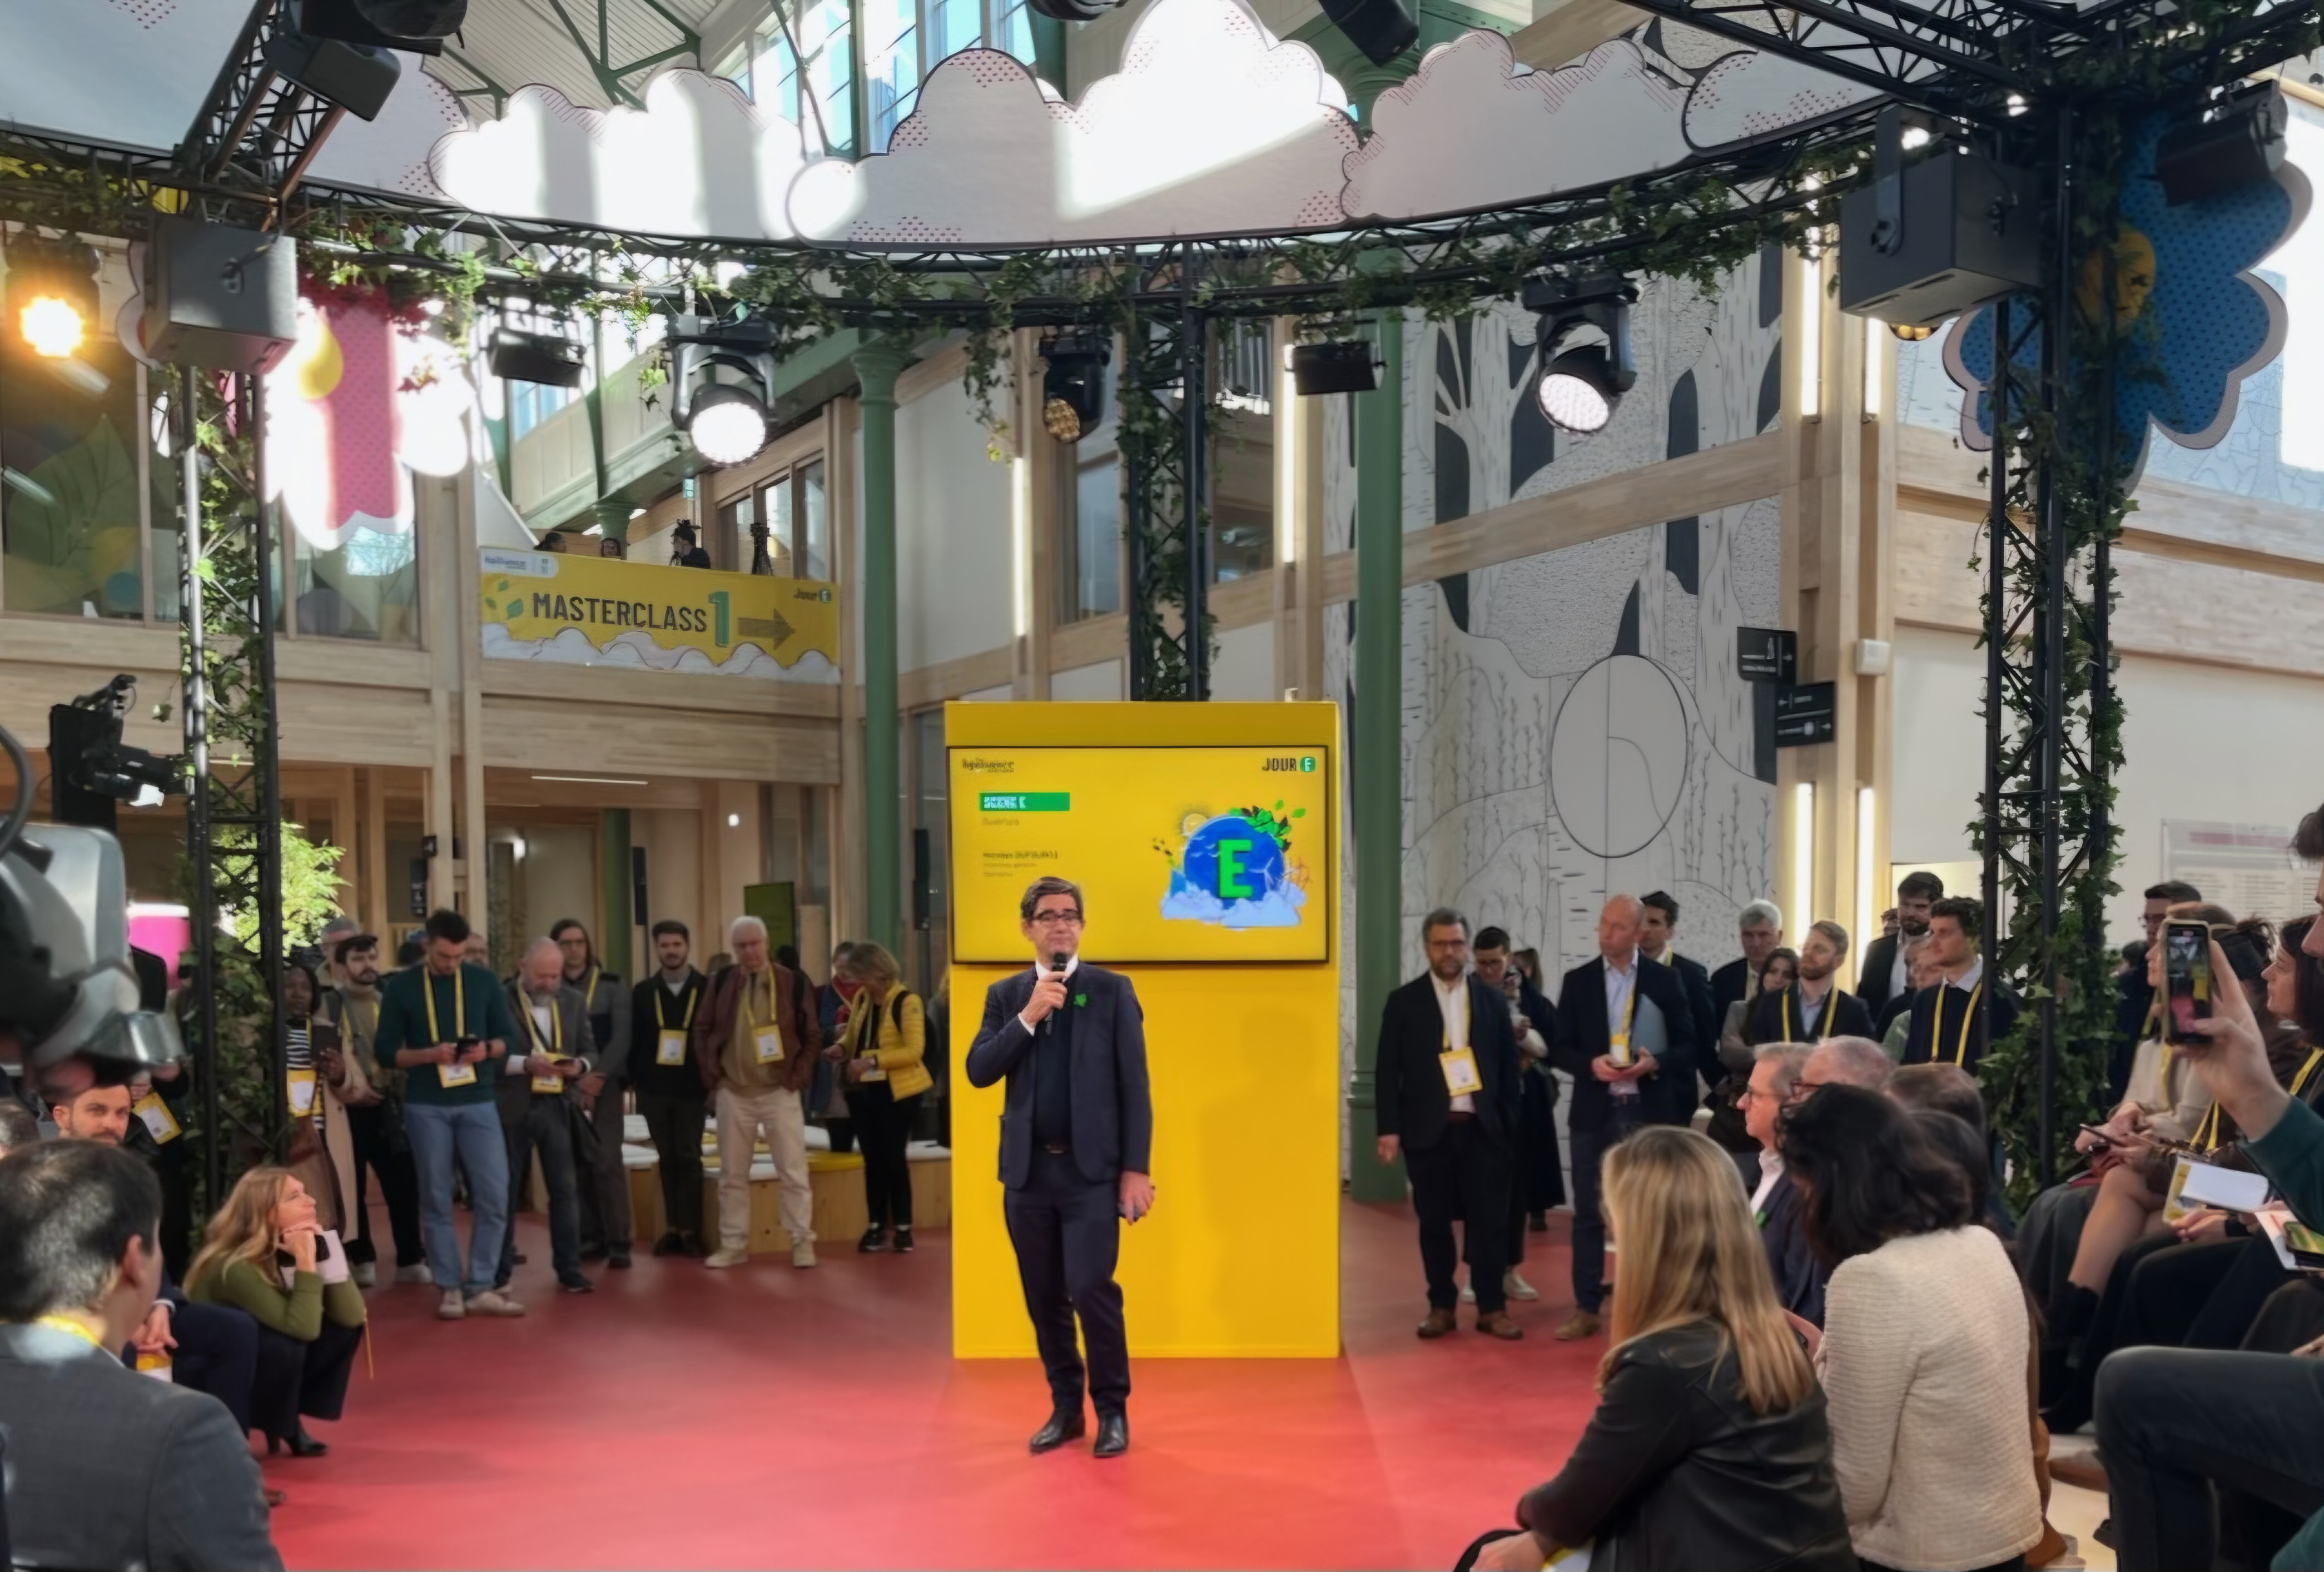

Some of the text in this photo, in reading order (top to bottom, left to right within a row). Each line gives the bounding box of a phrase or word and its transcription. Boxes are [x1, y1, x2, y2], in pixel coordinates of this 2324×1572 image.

[533, 591, 729, 648] MASTERCLASS 1
[1218, 838, 1253, 898] E
